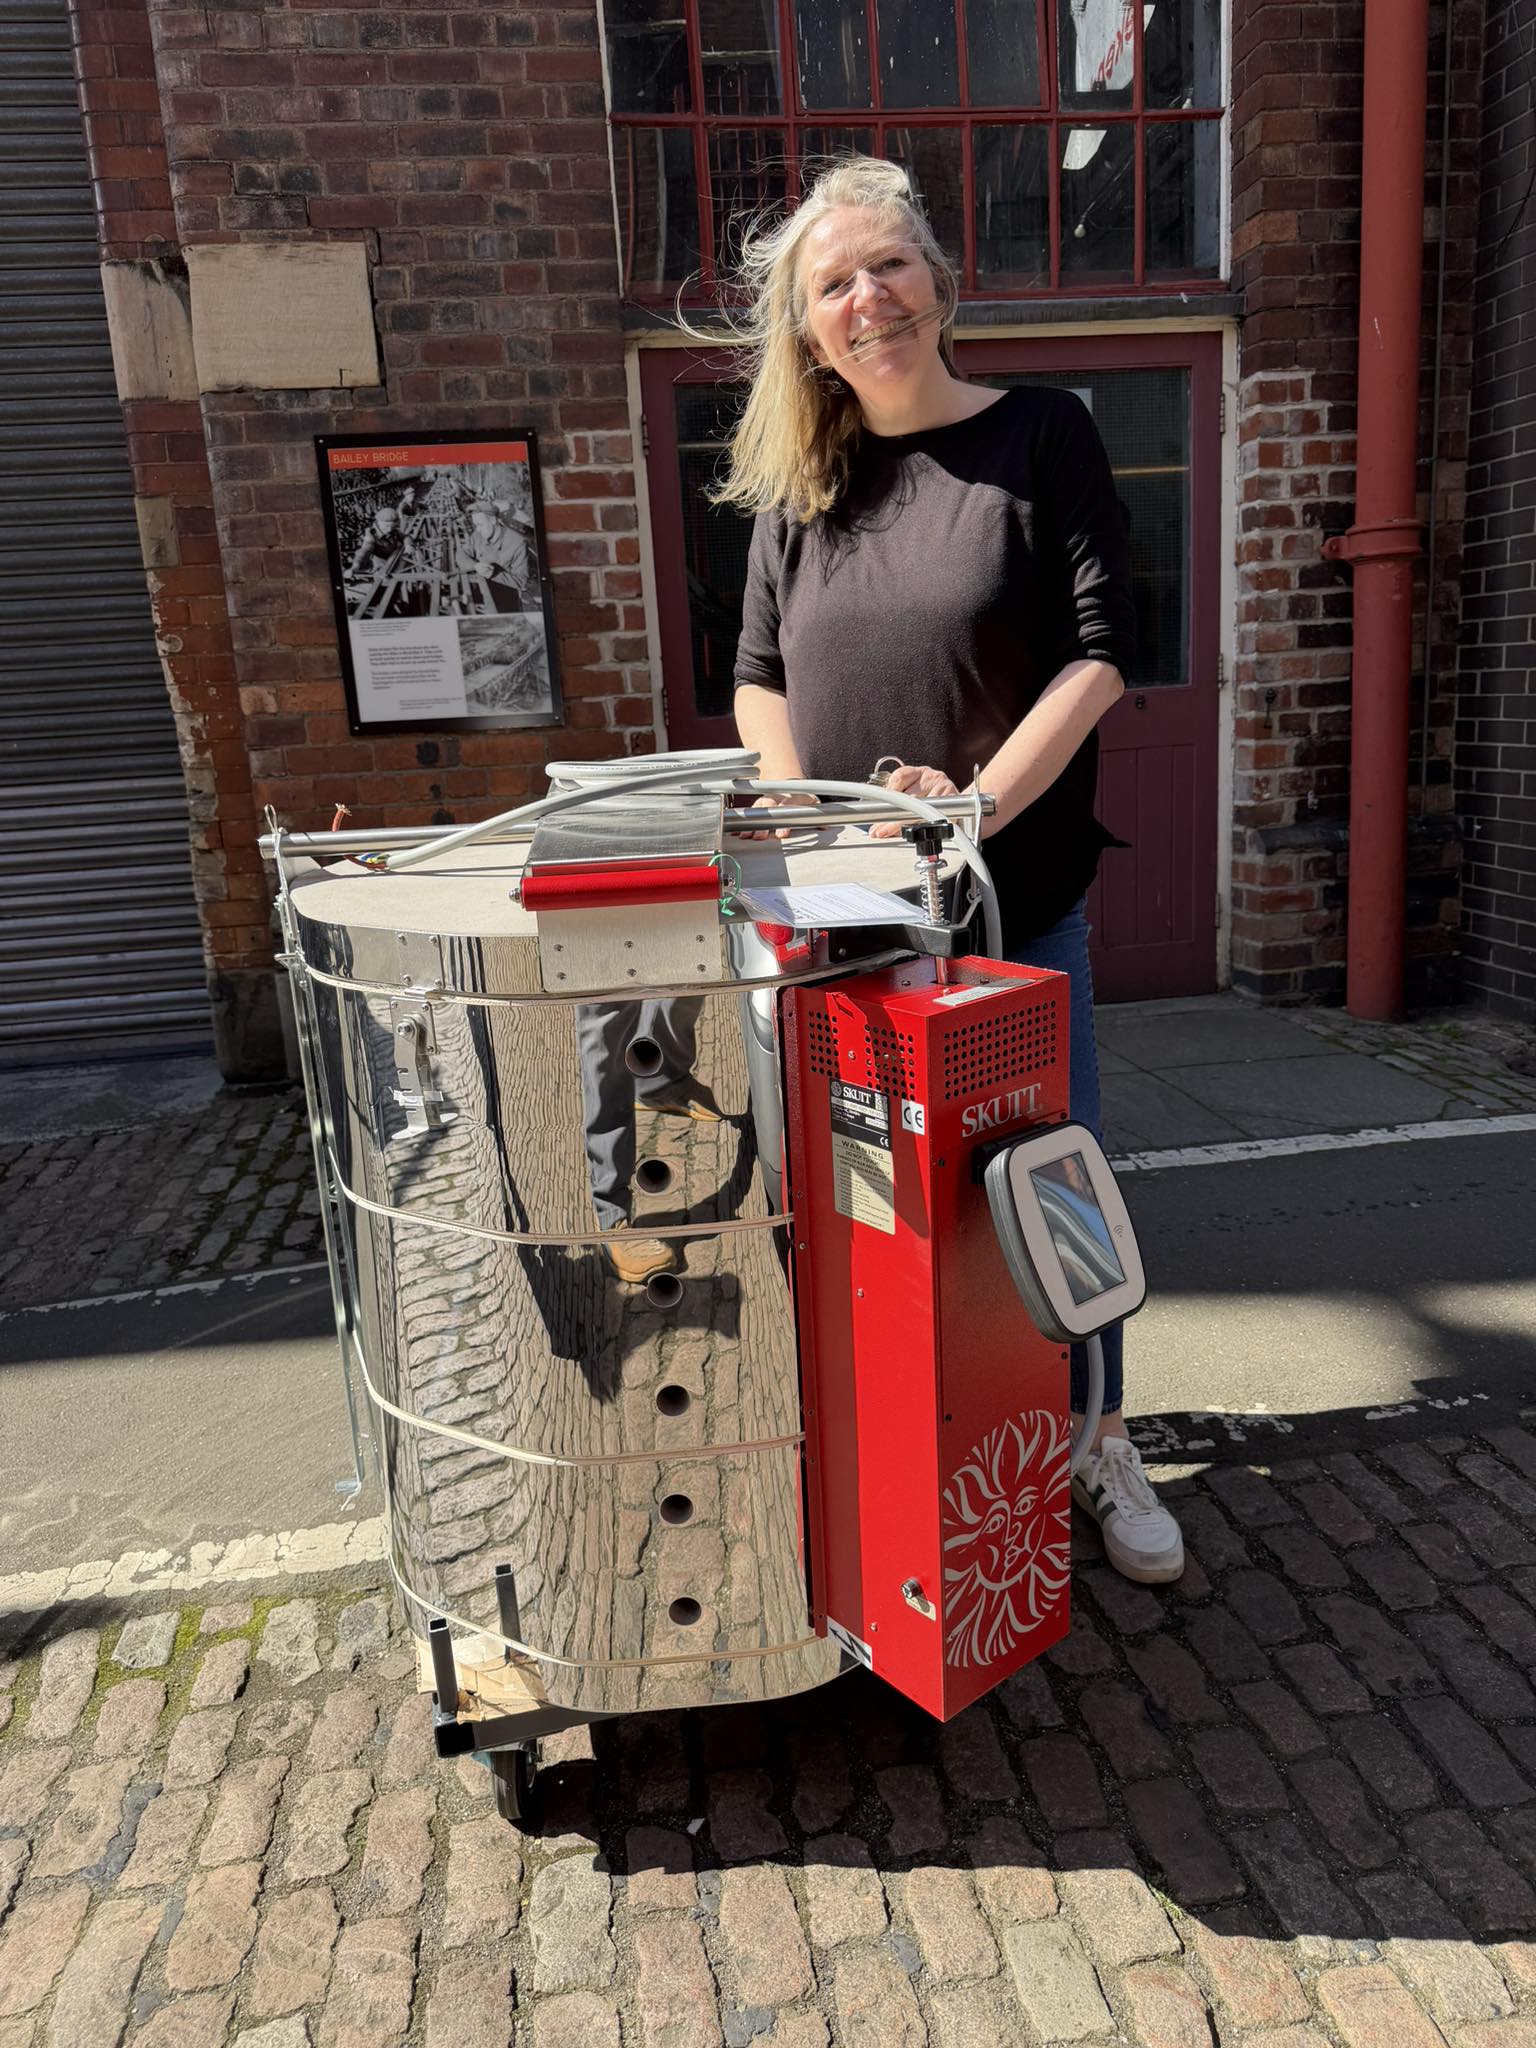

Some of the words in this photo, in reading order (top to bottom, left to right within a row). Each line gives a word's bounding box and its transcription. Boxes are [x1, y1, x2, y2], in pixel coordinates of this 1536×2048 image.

[333, 454, 368, 464] BAILEY
[372, 452, 409, 462] BRIDGE
[842, 1086, 872, 1104] SKUTT
[961, 1082, 1041, 1138] SKUTT
[841, 1140, 884, 1160] WARNING
